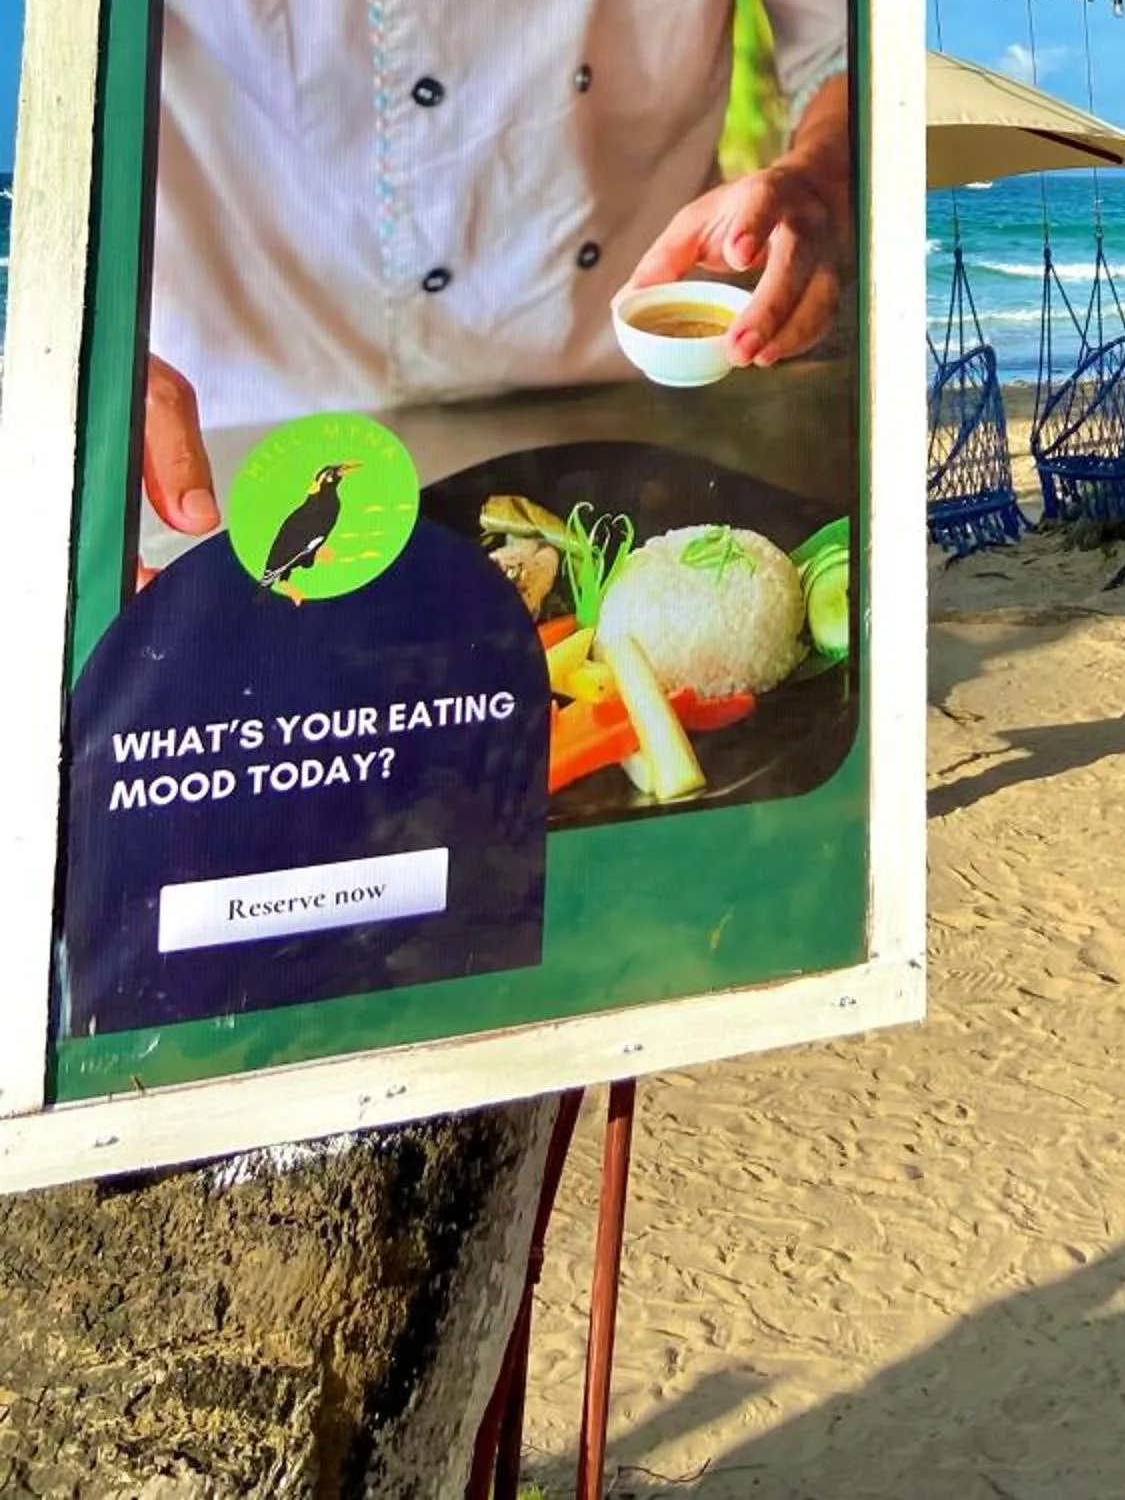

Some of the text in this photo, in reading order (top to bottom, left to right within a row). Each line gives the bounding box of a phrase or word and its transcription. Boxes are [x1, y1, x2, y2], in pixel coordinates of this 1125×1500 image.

[112, 691, 516, 763] WHAT'S YOUR EATING
[108, 747, 395, 811] MOOD TODAY?
[228, 886, 387, 923] Reserve now
